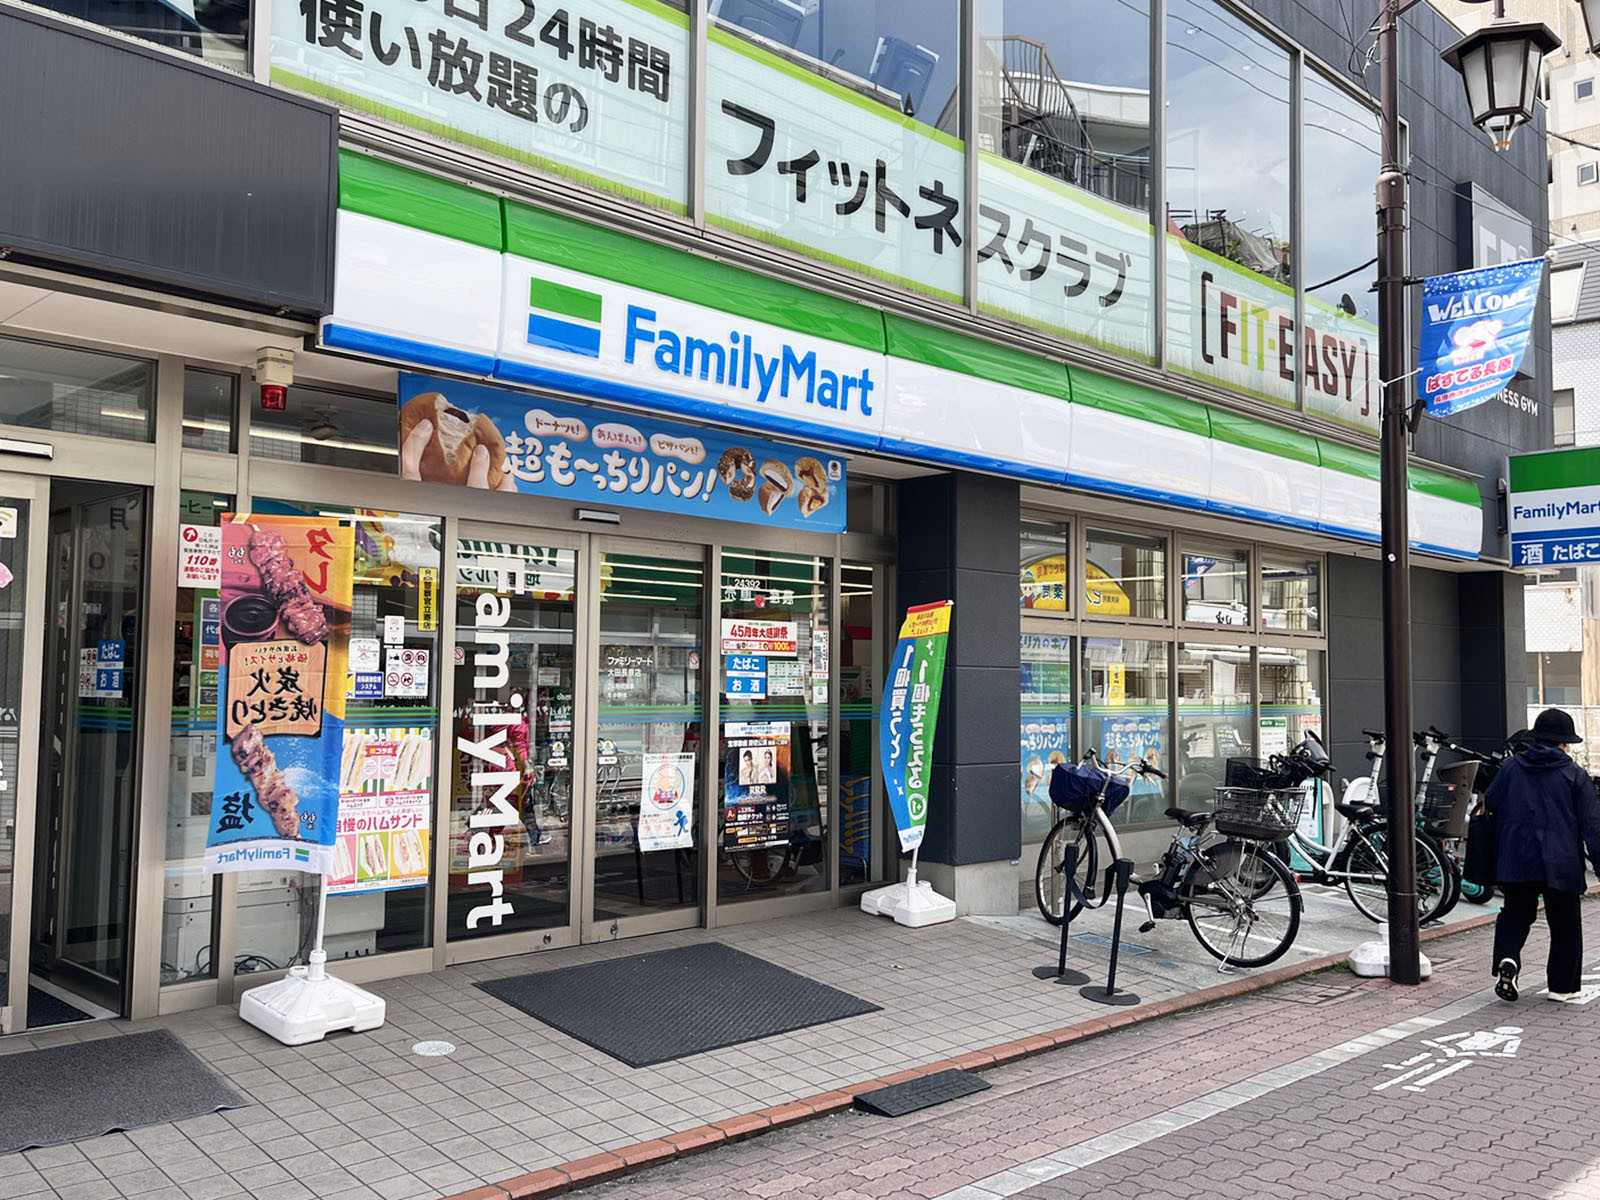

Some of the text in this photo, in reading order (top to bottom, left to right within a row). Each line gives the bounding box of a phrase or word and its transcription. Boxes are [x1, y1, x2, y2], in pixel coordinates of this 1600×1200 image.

[415, 0, 670, 103] 日24時間
[298, 0, 589, 133] 使い放題の
[720, 98, 1134, 308] フィットネスクラブ
[624, 303, 875, 417] FamilyMart
[1520, 395, 1539, 417] GYM
[1513, 500, 1600, 520] FamilyMart
[1520, 542, 1600, 565] 酒 たばこ
[734, 578, 761, 589] 24392
[607, 654, 654, 667] ファミリーマート
[732, 657, 760, 670] たばこ
[457, 555, 525, 930] FamilyMart
